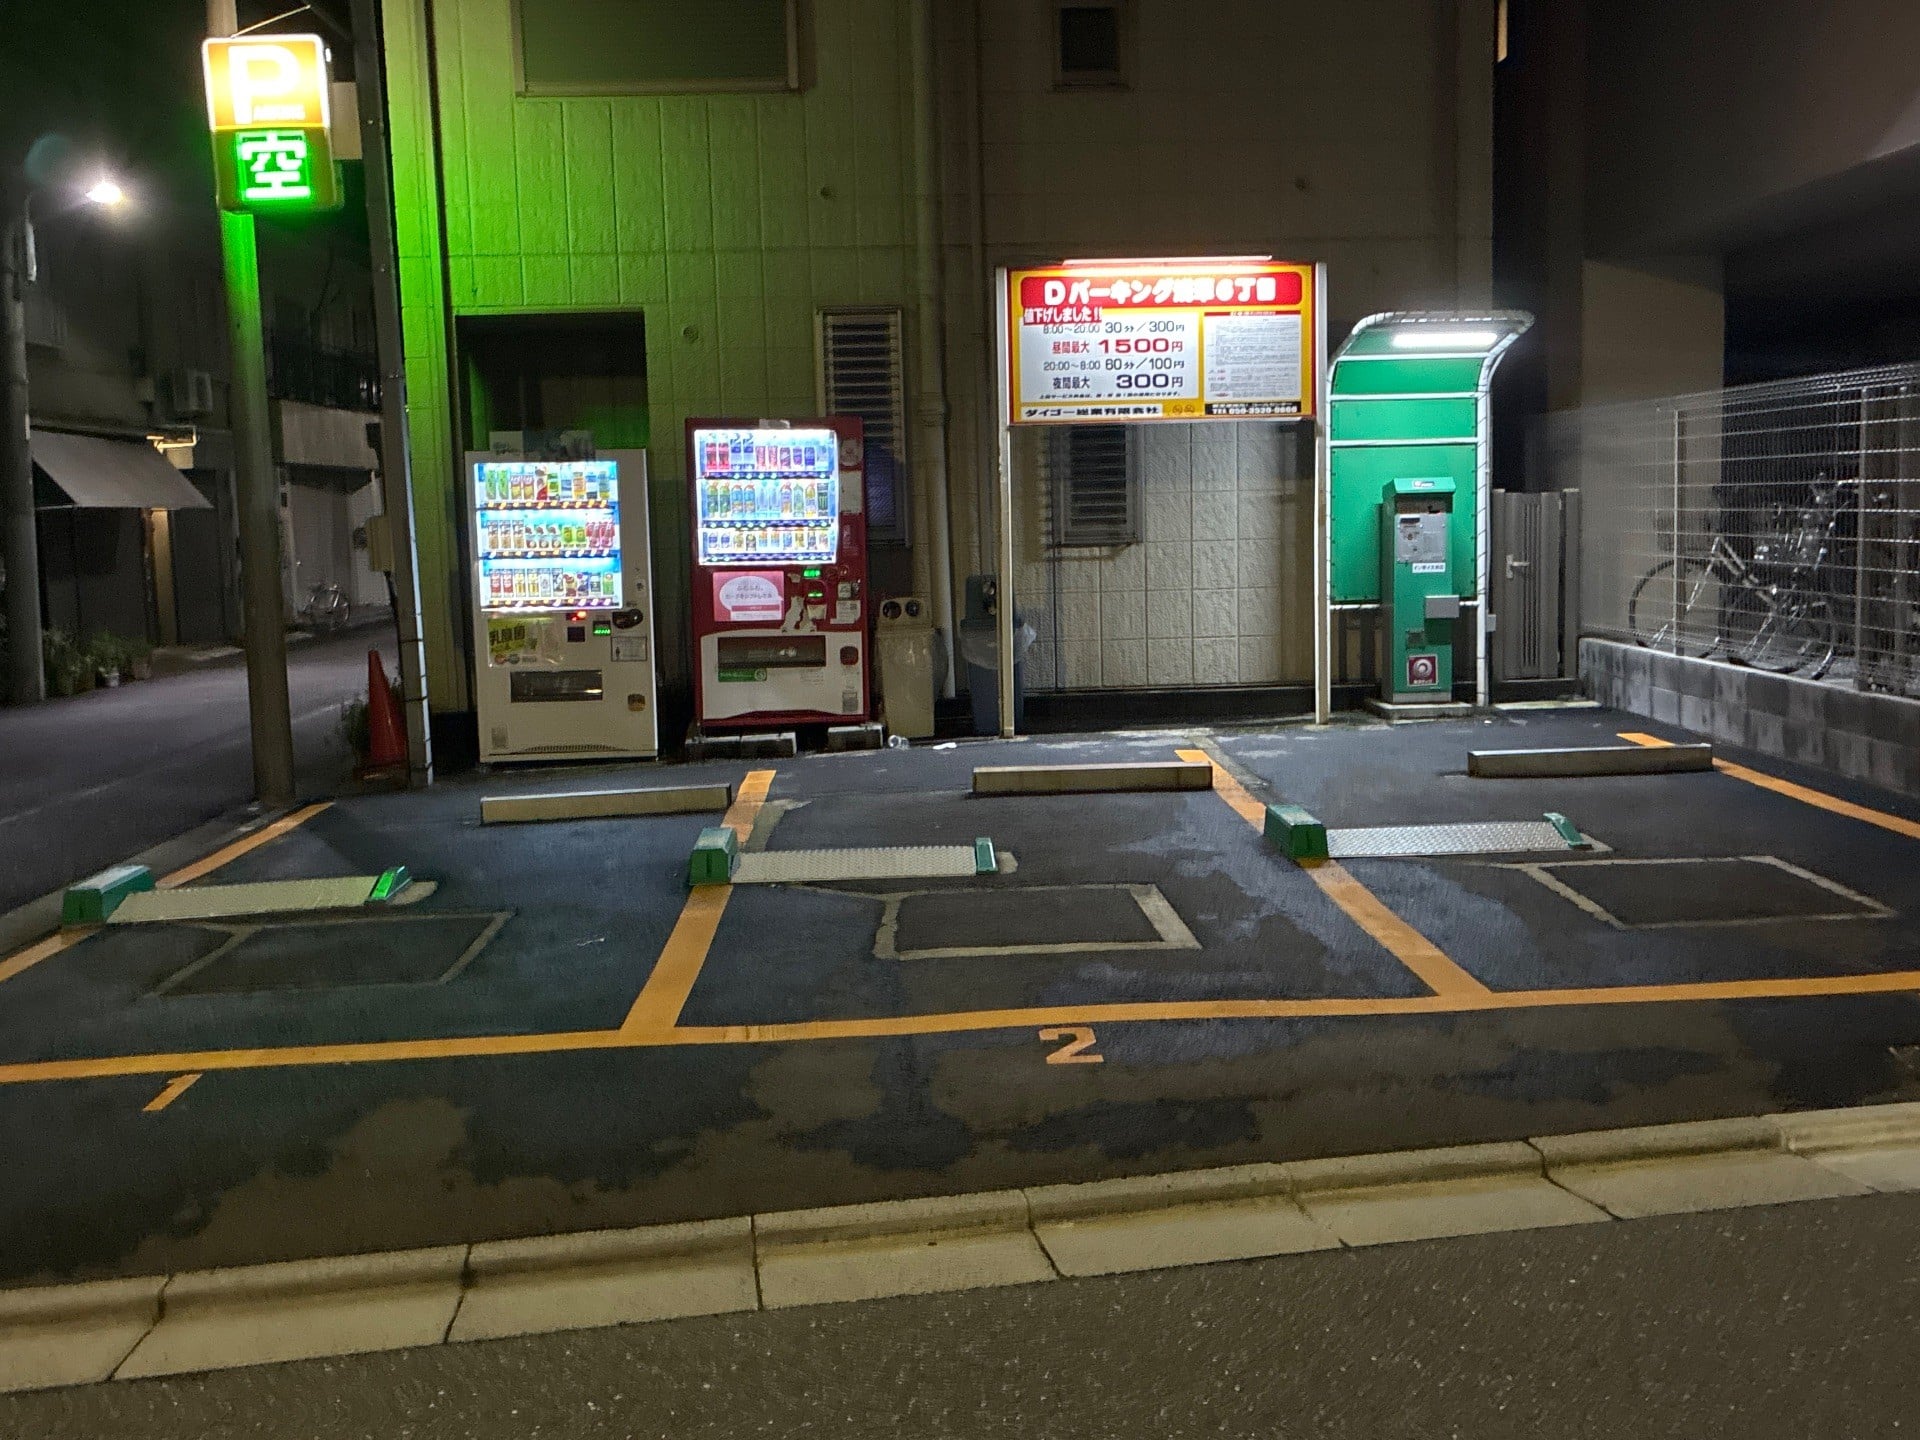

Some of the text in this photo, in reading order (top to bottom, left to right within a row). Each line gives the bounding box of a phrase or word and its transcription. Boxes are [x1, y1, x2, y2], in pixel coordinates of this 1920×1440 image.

[228, 45, 301, 124] P
[241, 131, 310, 198] 空
[1052, 338, 1183, 354] 昼間最大 1500円
[1053, 374, 1183, 389] 夜間最大 300円
[1039, 1027, 1104, 1064] 2
[142, 1073, 203, 1111] 1
